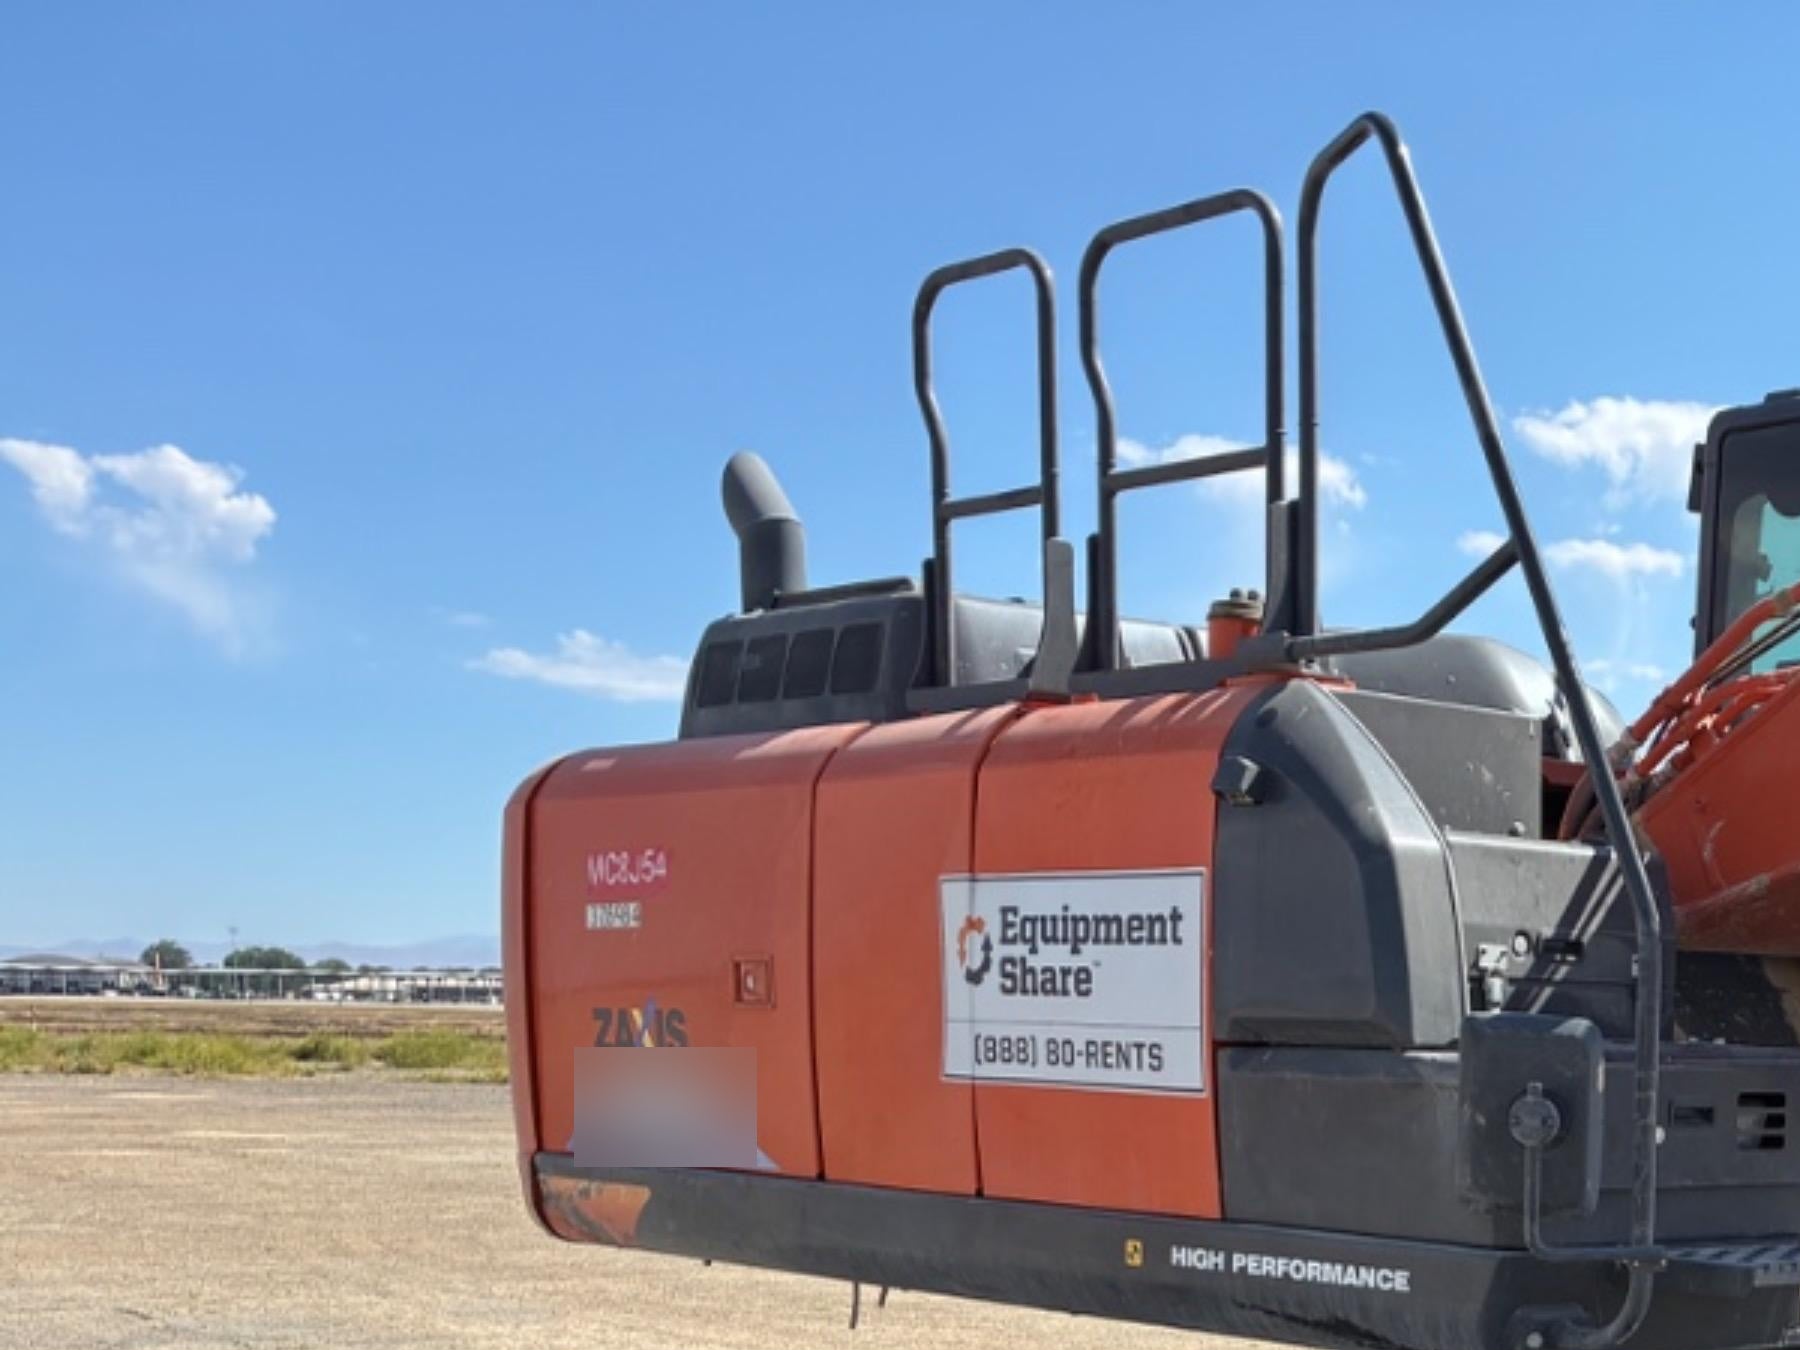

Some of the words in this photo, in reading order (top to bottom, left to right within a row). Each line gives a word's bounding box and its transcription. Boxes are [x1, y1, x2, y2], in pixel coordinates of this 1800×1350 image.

[998, 904, 1183, 955] Equipment
[998, 956, 1093, 997] Share
[974, 1033, 1037, 1068] (888)
[1046, 1037, 1164, 1072] 80-RENTS
[1170, 1244, 1226, 1272] HIGH
[1231, 1252, 1411, 1292] PERFORMANCE
